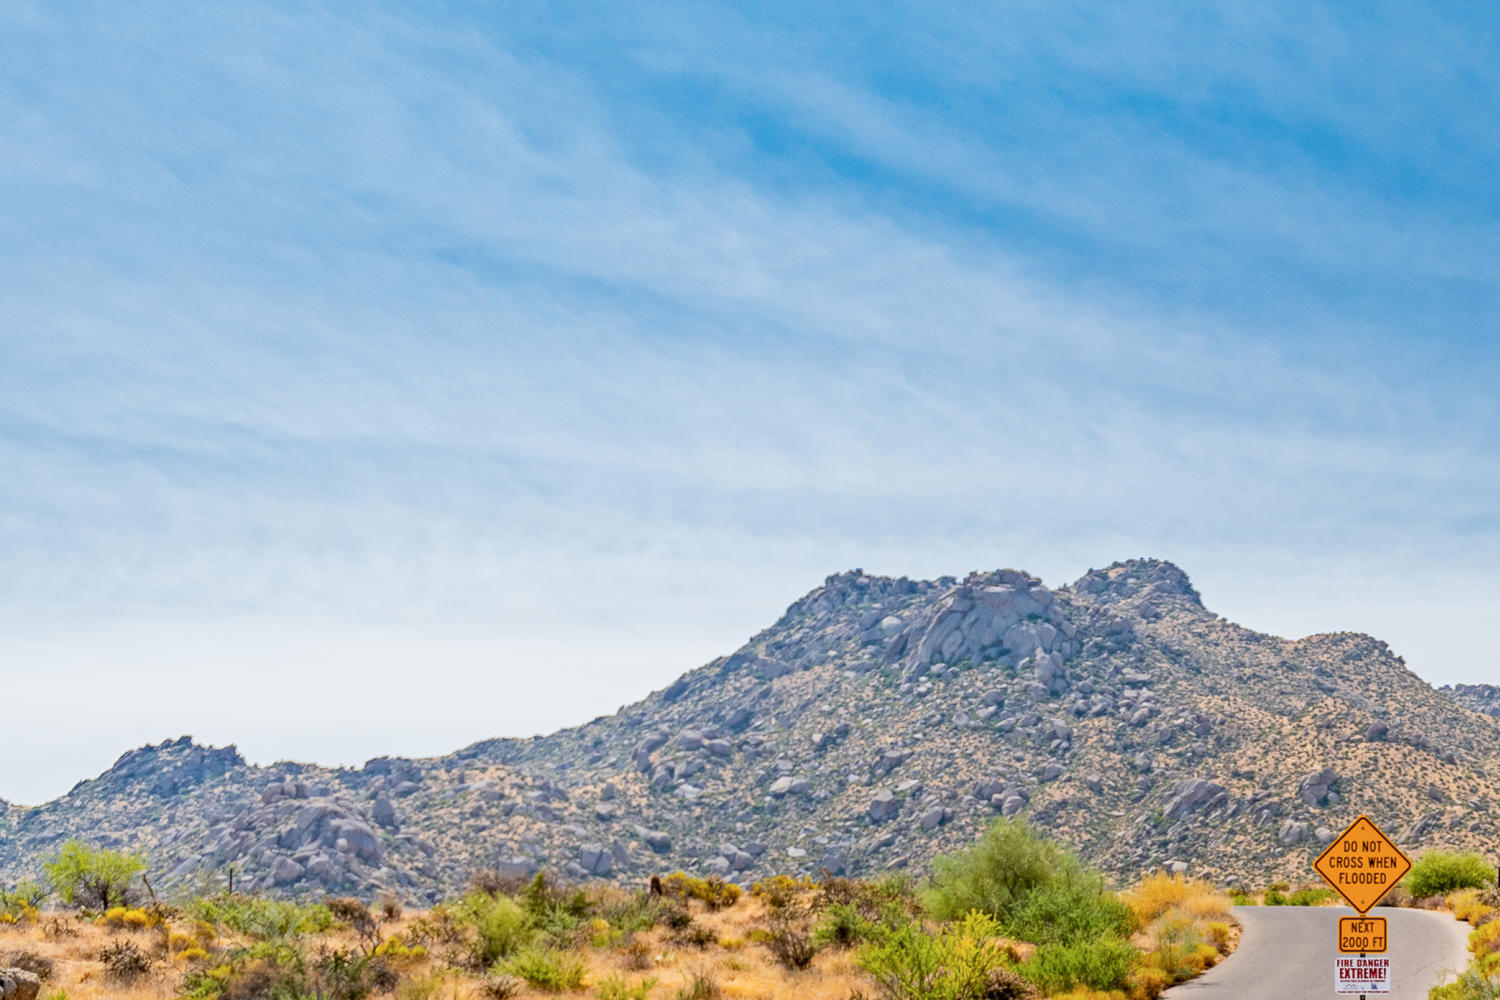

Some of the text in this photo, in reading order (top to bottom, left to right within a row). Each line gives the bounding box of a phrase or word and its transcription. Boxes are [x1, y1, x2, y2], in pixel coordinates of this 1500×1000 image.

[1344, 841, 1382, 852] DO NOT
[1329, 857, 1397, 868] CROSS WHEN
[1339, 873, 1386, 884] FLOODED
[1351, 922, 1375, 933] NEXT
[1343, 937, 1384, 948] 2000 FT
[1336, 959, 1390, 967] FIRE DANGER
[1339, 967, 1387, 979] EXTREME!
